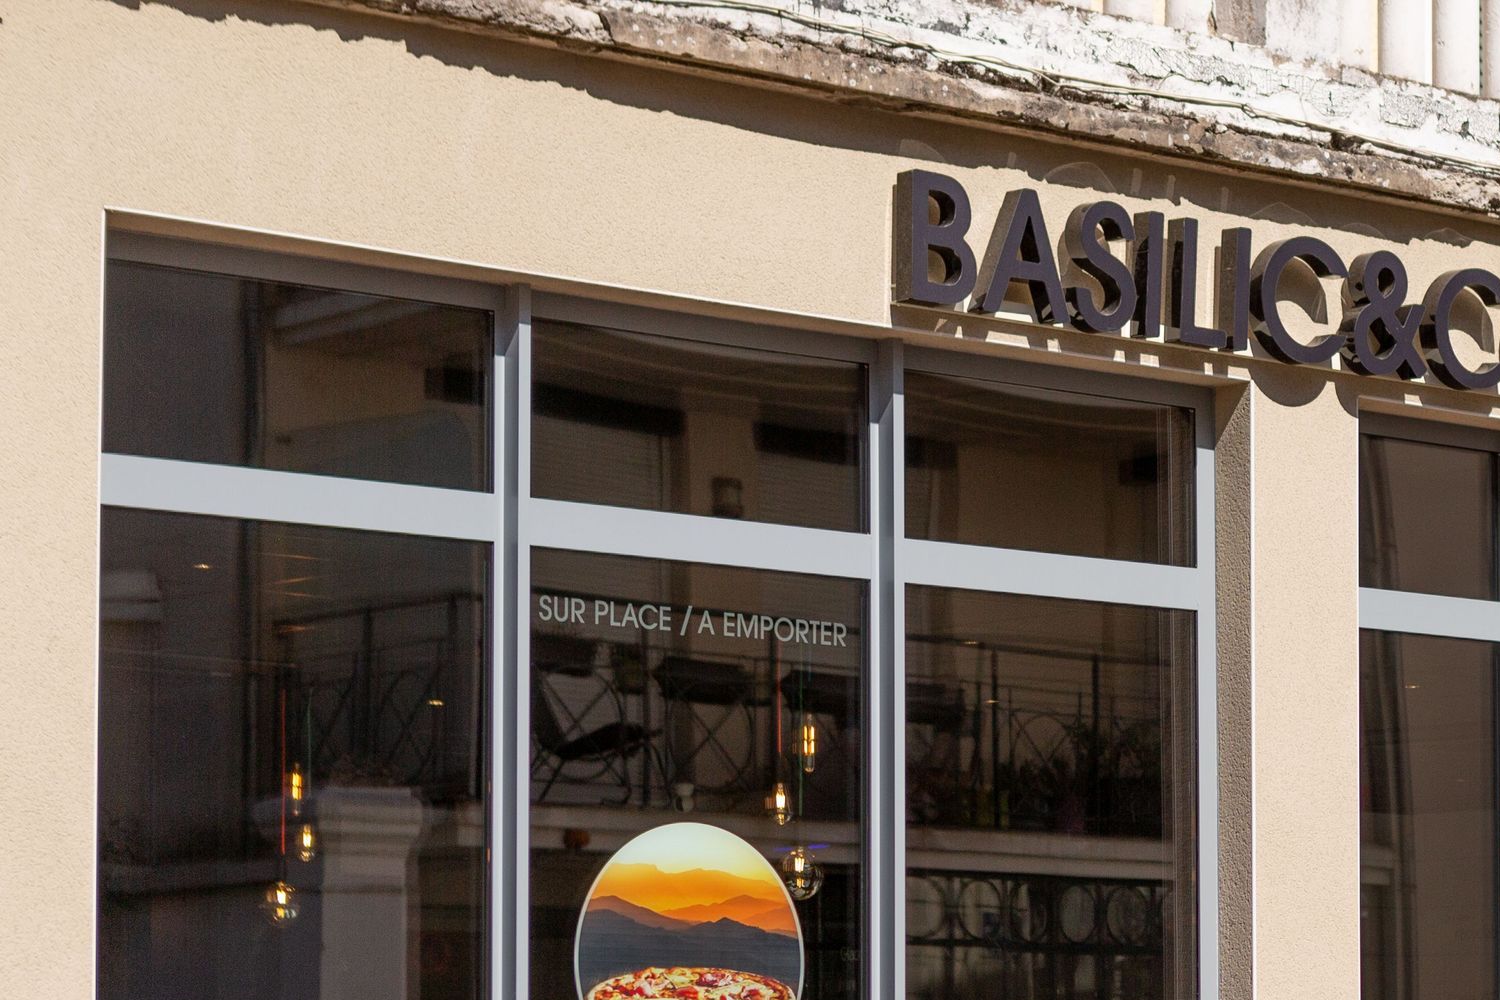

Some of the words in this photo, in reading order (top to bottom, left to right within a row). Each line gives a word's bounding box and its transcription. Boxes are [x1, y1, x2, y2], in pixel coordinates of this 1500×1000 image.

[538, 594, 585, 624] SUR
[594, 600, 672, 632] PLACE
[698, 609, 715, 635] A
[723, 611, 847, 648] EMPORTER
